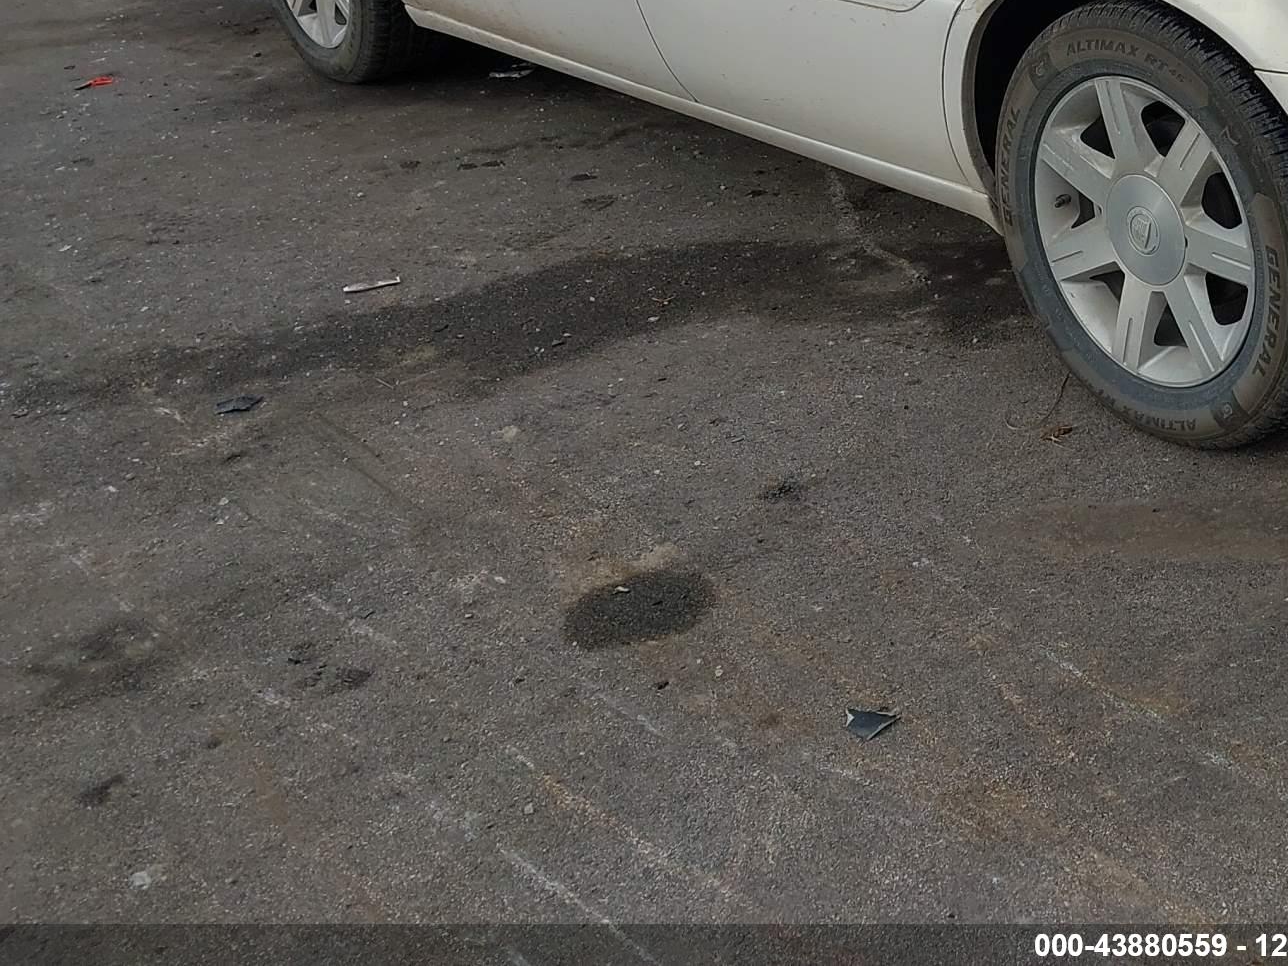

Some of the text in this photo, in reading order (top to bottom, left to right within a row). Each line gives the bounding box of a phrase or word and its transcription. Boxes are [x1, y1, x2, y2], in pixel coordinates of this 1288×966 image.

[1066, 38, 1140, 57] ALTIMAX
[1000, 106, 1020, 227] GENERAL
[1254, 245, 1282, 377] GENERAL
